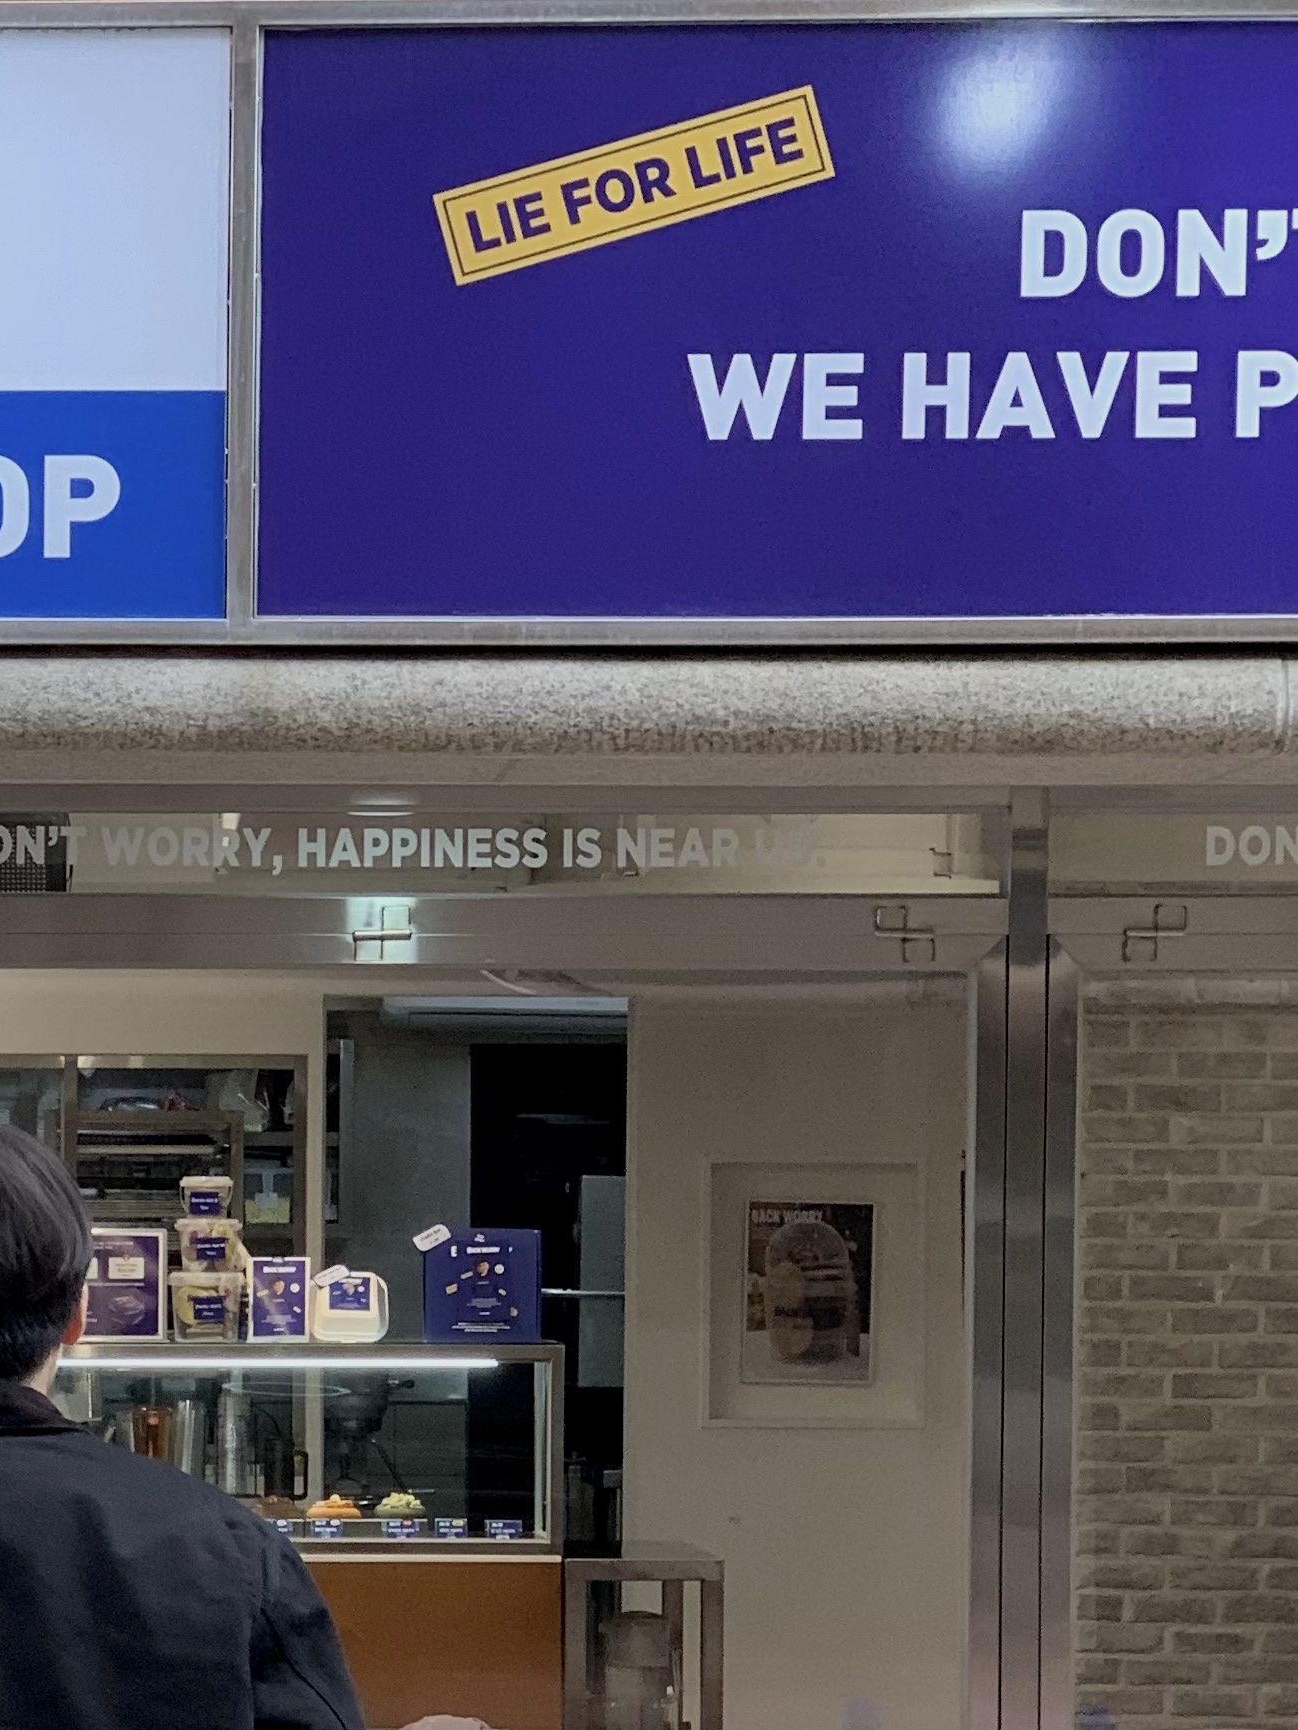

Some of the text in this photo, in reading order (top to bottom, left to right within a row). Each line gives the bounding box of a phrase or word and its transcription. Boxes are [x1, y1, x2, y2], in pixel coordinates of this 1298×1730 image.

[465, 117, 804, 253] LIE FOR LIFE
[1021, 208, 1298, 297] DON'
[688, 353, 864, 441] WE
[903, 351, 1198, 441] HAVE
[103, 826, 284, 875] WORRY,
[297, 827, 548, 868] HAPPINESS
[562, 828, 602, 869] IS
[616, 828, 740, 868] NEAR
